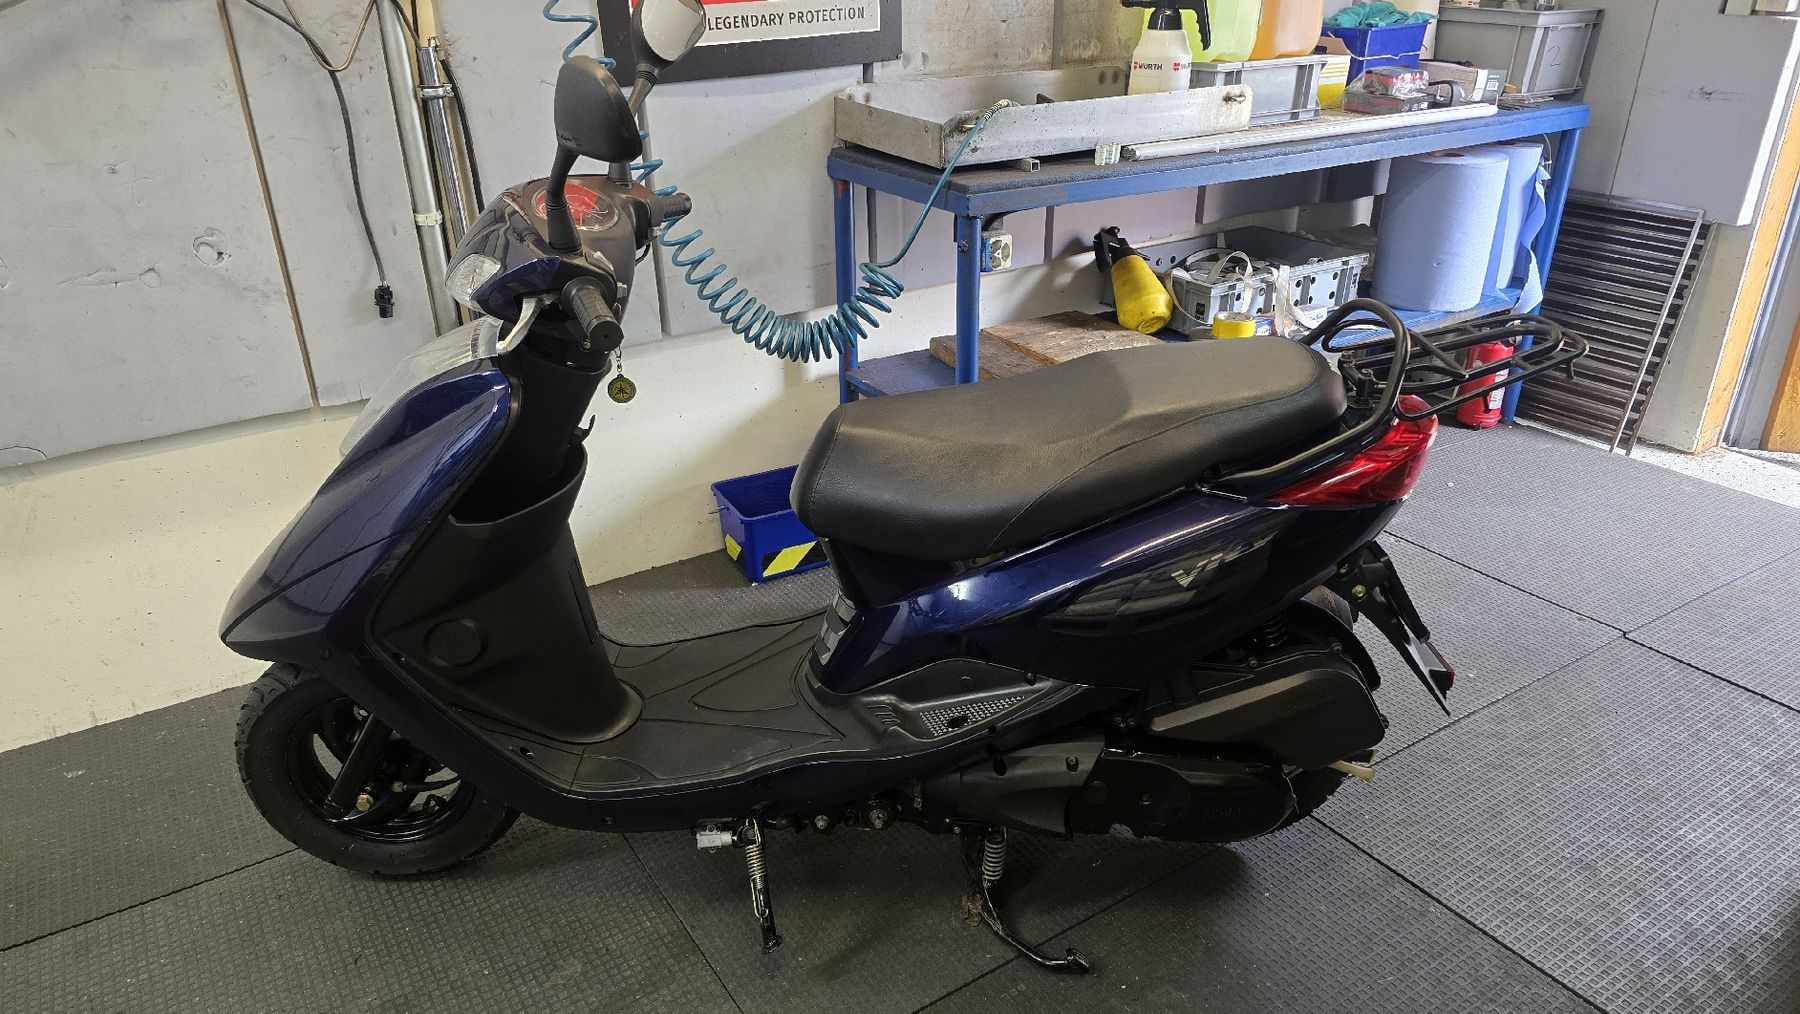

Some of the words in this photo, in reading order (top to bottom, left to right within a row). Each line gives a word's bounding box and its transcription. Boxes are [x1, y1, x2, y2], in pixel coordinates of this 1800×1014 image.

[708, 13, 784, 31] LEGENDARY
[789, 6, 865, 24] PROTECTION
[1545, 46, 1562, 67] 2
